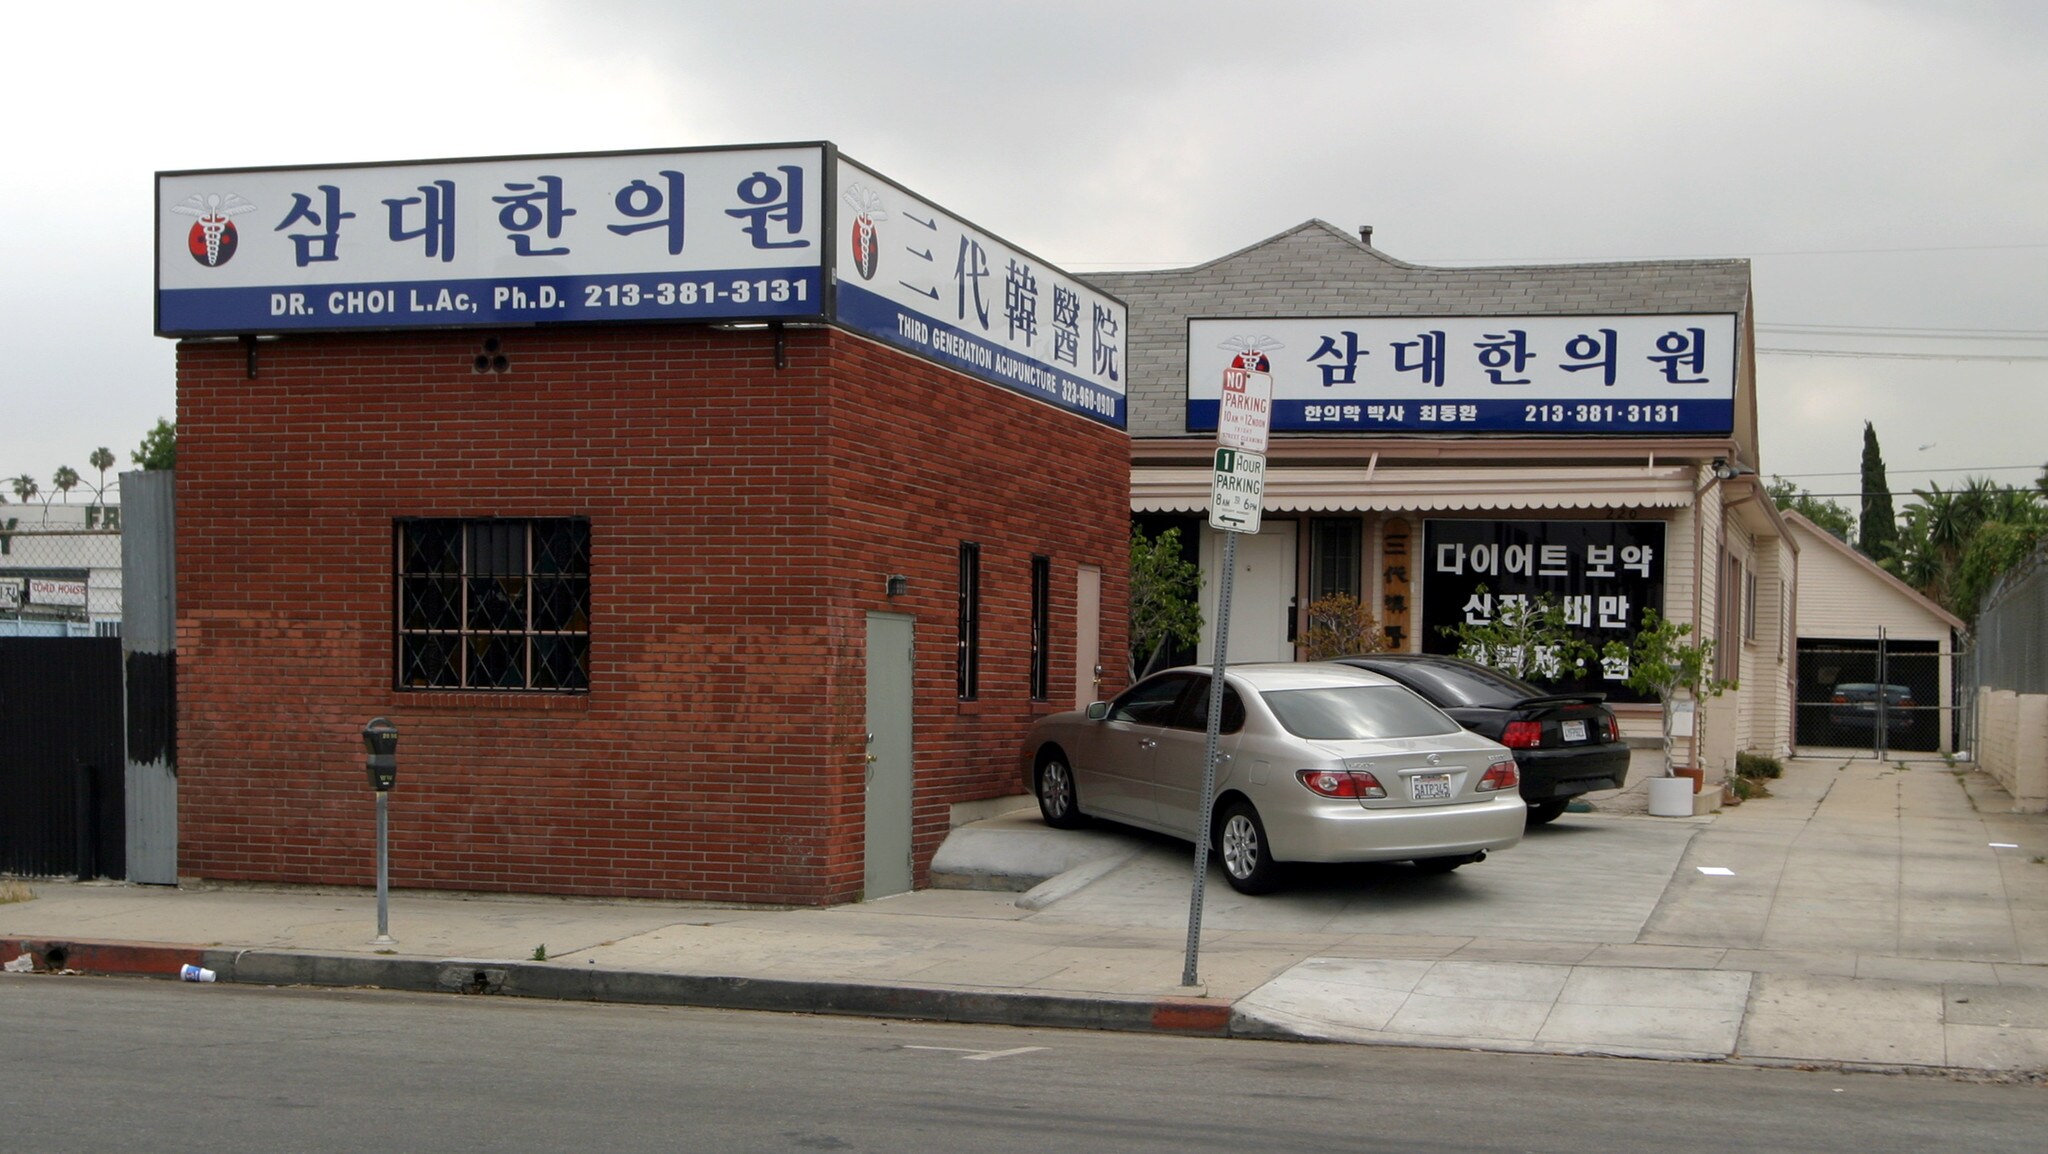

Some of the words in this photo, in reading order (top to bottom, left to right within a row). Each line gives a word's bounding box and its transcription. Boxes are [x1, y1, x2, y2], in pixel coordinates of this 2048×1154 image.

[275, 165, 811, 268] 삼대한의원
[271, 293, 314, 316] DR.
[328, 290, 395, 314] CHOI
[410, 289, 477, 315] L.Ac,
[494, 286, 566, 310] Ph.D.
[584, 278, 808, 307] 213-381-3131
[899, 211, 1119, 383] 三代韓醫院
[897, 312, 929, 345] THIRD
[932, 328, 992, 370] GENERATION
[995, 353, 1057, 395] ACUPUNCTURE
[1306, 327, 1710, 388] 삼대한의원
[1227, 371, 1243, 390] NO
[1225, 393, 1267, 413] PARKING
[1304, 405, 1361, 422] 한의학
[1367, 405, 1405, 422] 박사
[1419, 405, 1478, 422] 최동환
[1224, 453, 1230, 470] 1
[1236, 457, 1261, 474] HOUR
[1217, 474, 1260, 495] PARKING
[1606, 508, 1637, 519] 220
[1437, 543, 1568, 577] 다이어트
[1586, 544, 1653, 578] 보약
[1563, 594, 1630, 628] 비만
